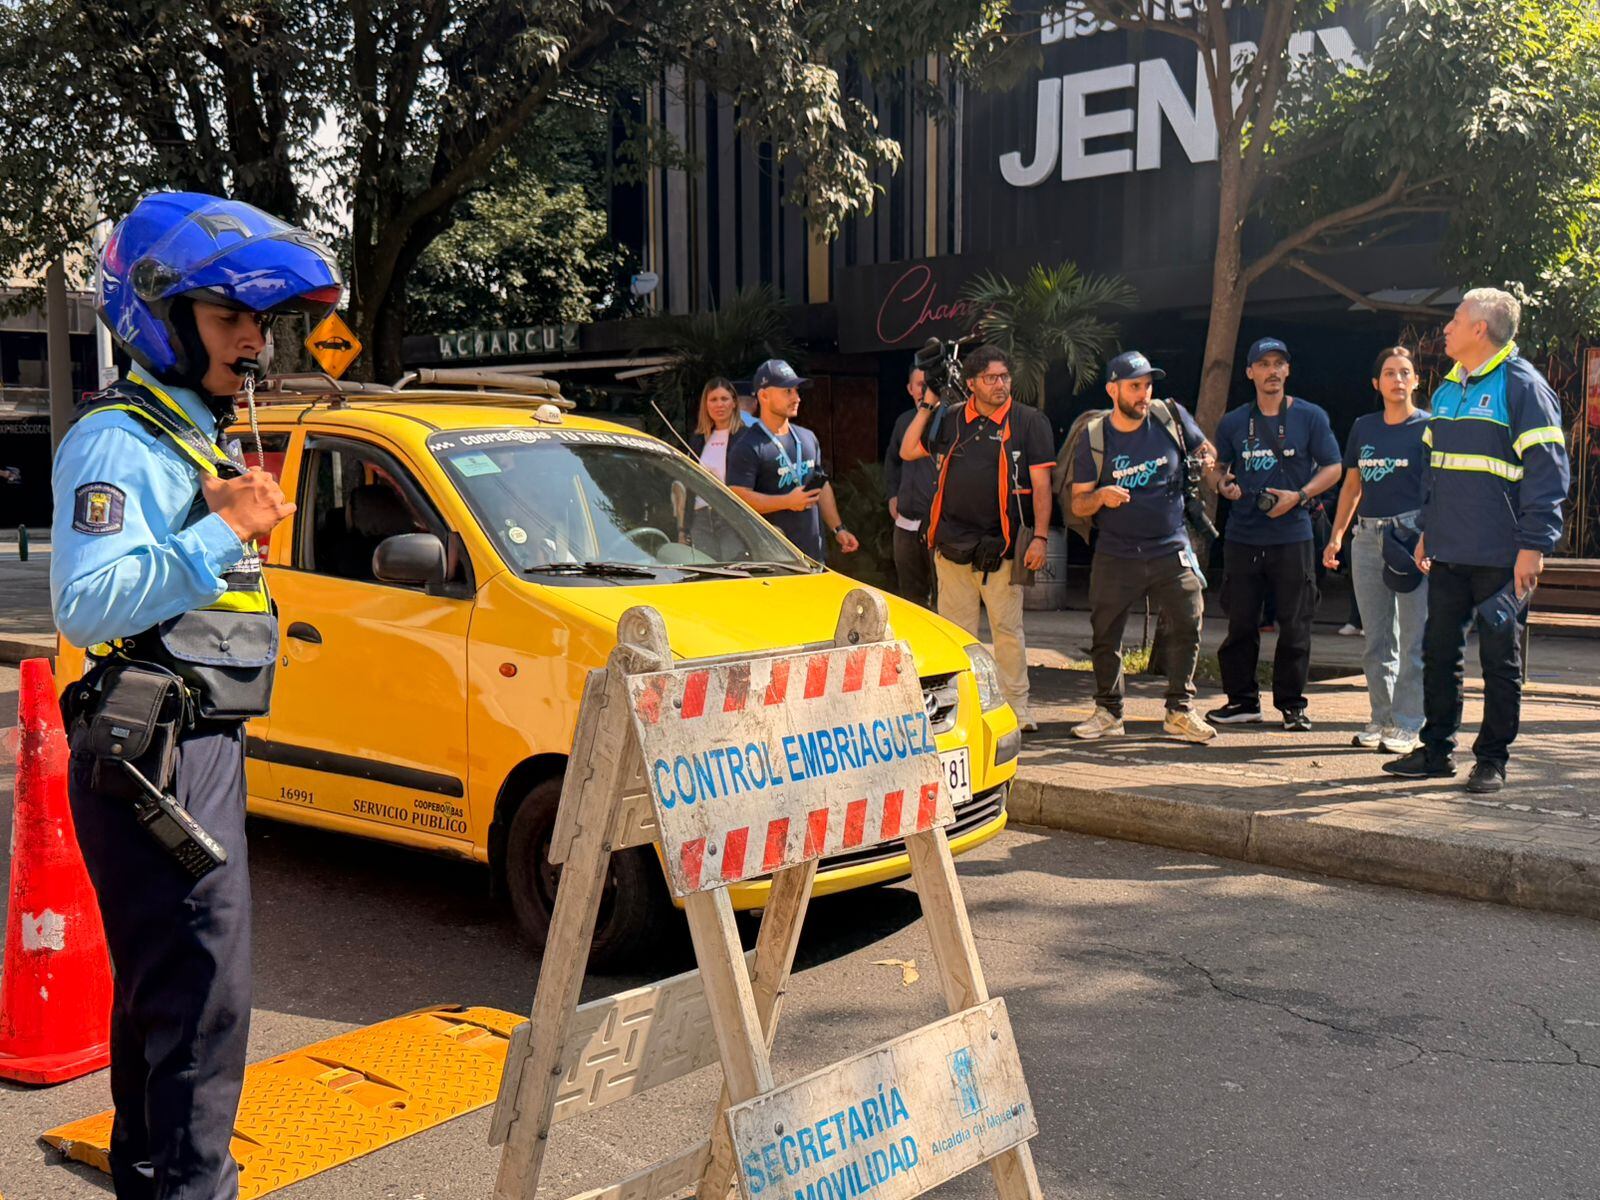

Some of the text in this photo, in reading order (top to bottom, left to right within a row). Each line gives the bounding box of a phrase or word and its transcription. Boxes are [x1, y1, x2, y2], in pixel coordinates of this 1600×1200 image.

[552, 431, 580, 441] TU
[576, 432, 616, 444] TAXI
[654, 711, 936, 810] CONTROL EMBRIAGUEZ
[280, 787, 314, 804] 16991
[353, 799, 467, 834] SERVICIO PUBLICO
[743, 1082, 909, 1194] SECRETARÍA
